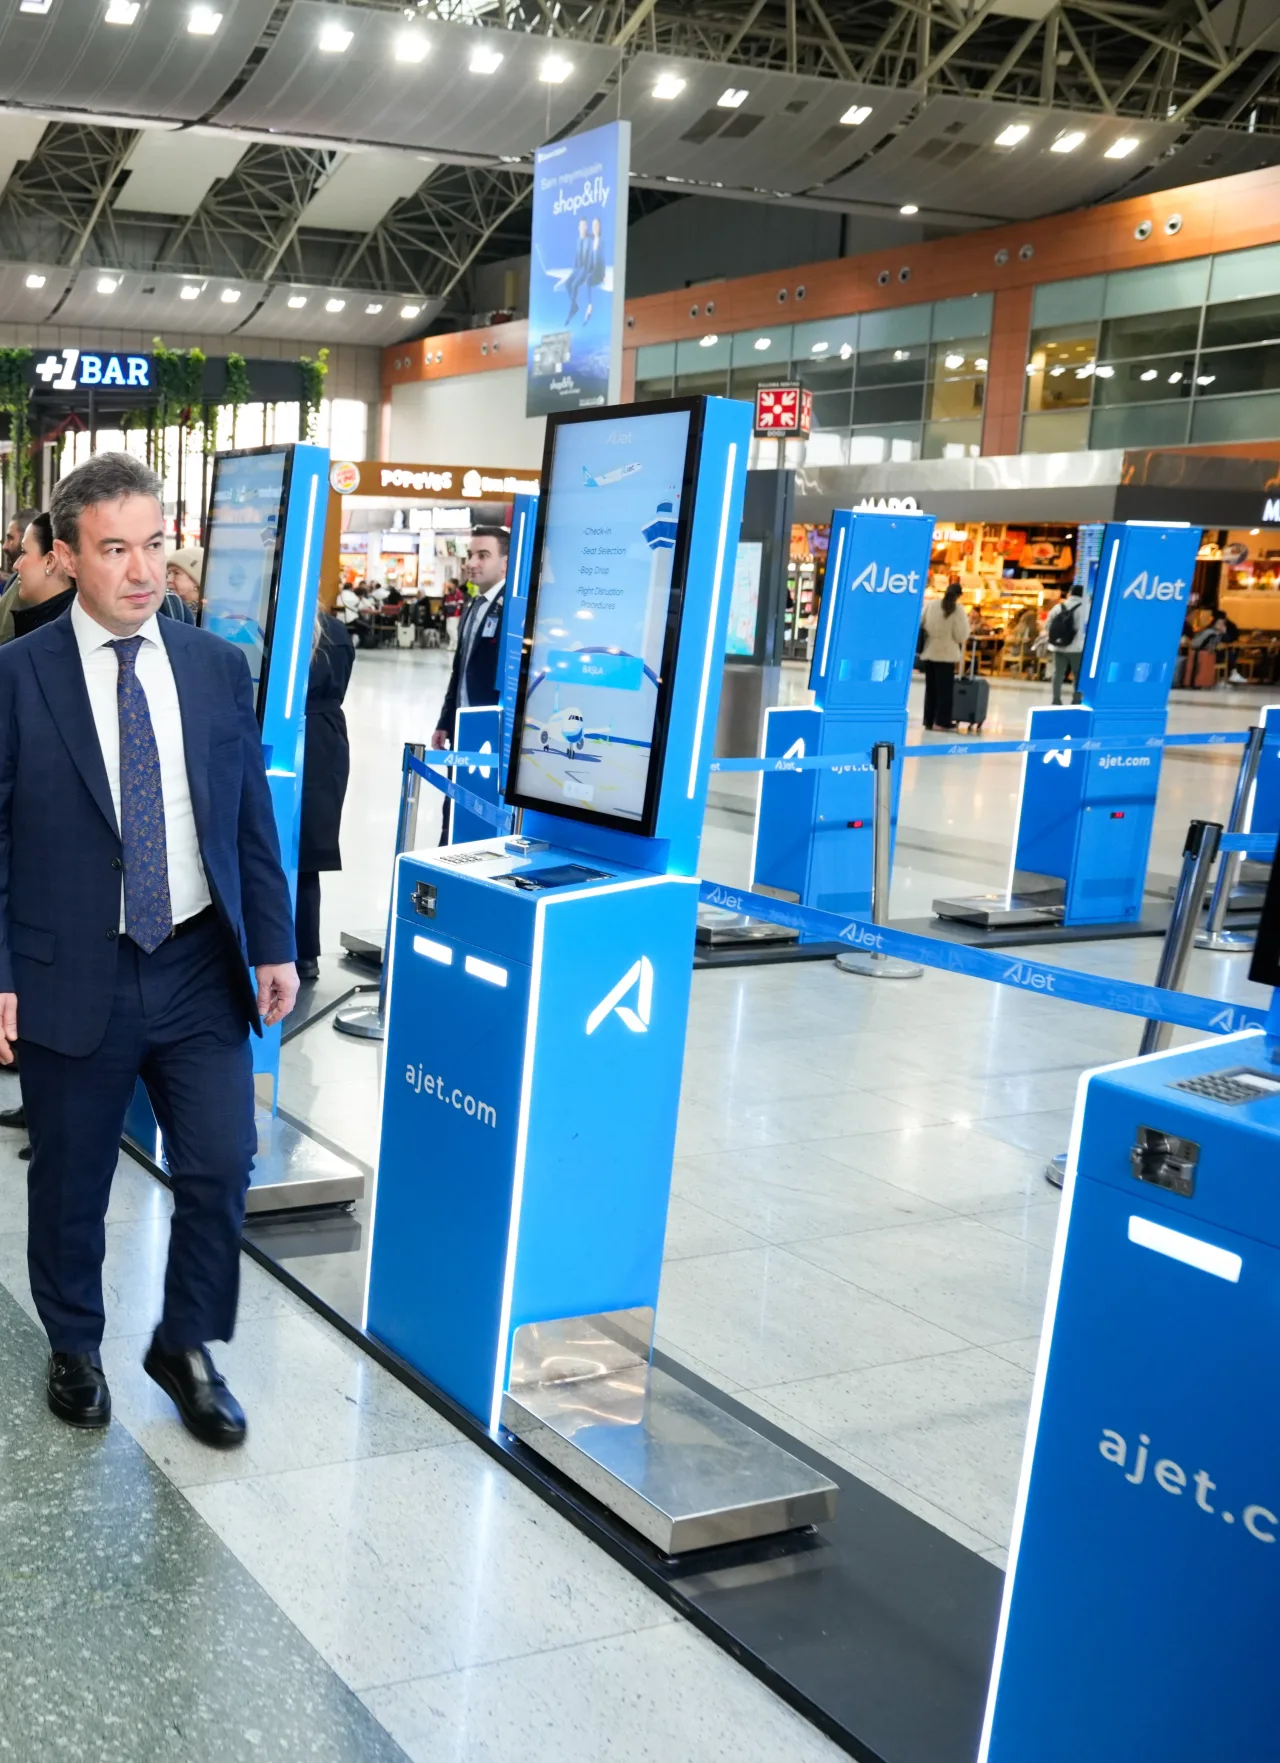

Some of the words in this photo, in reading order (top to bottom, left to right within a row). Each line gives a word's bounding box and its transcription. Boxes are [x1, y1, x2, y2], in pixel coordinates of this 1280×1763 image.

[553, 176, 610, 215] shop&fly
[80, 355, 149, 386] BAR
[851, 562, 920, 594] AJet
[1123, 571, 1186, 601] AJet
[444, 754, 471, 765] AJet
[1098, 754, 1151, 769] ajet.com
[706, 886, 744, 910] AJet
[839, 922, 884, 949] AJet
[1003, 963, 1057, 991] AJet
[405, 1063, 497, 1129] ajet.com
